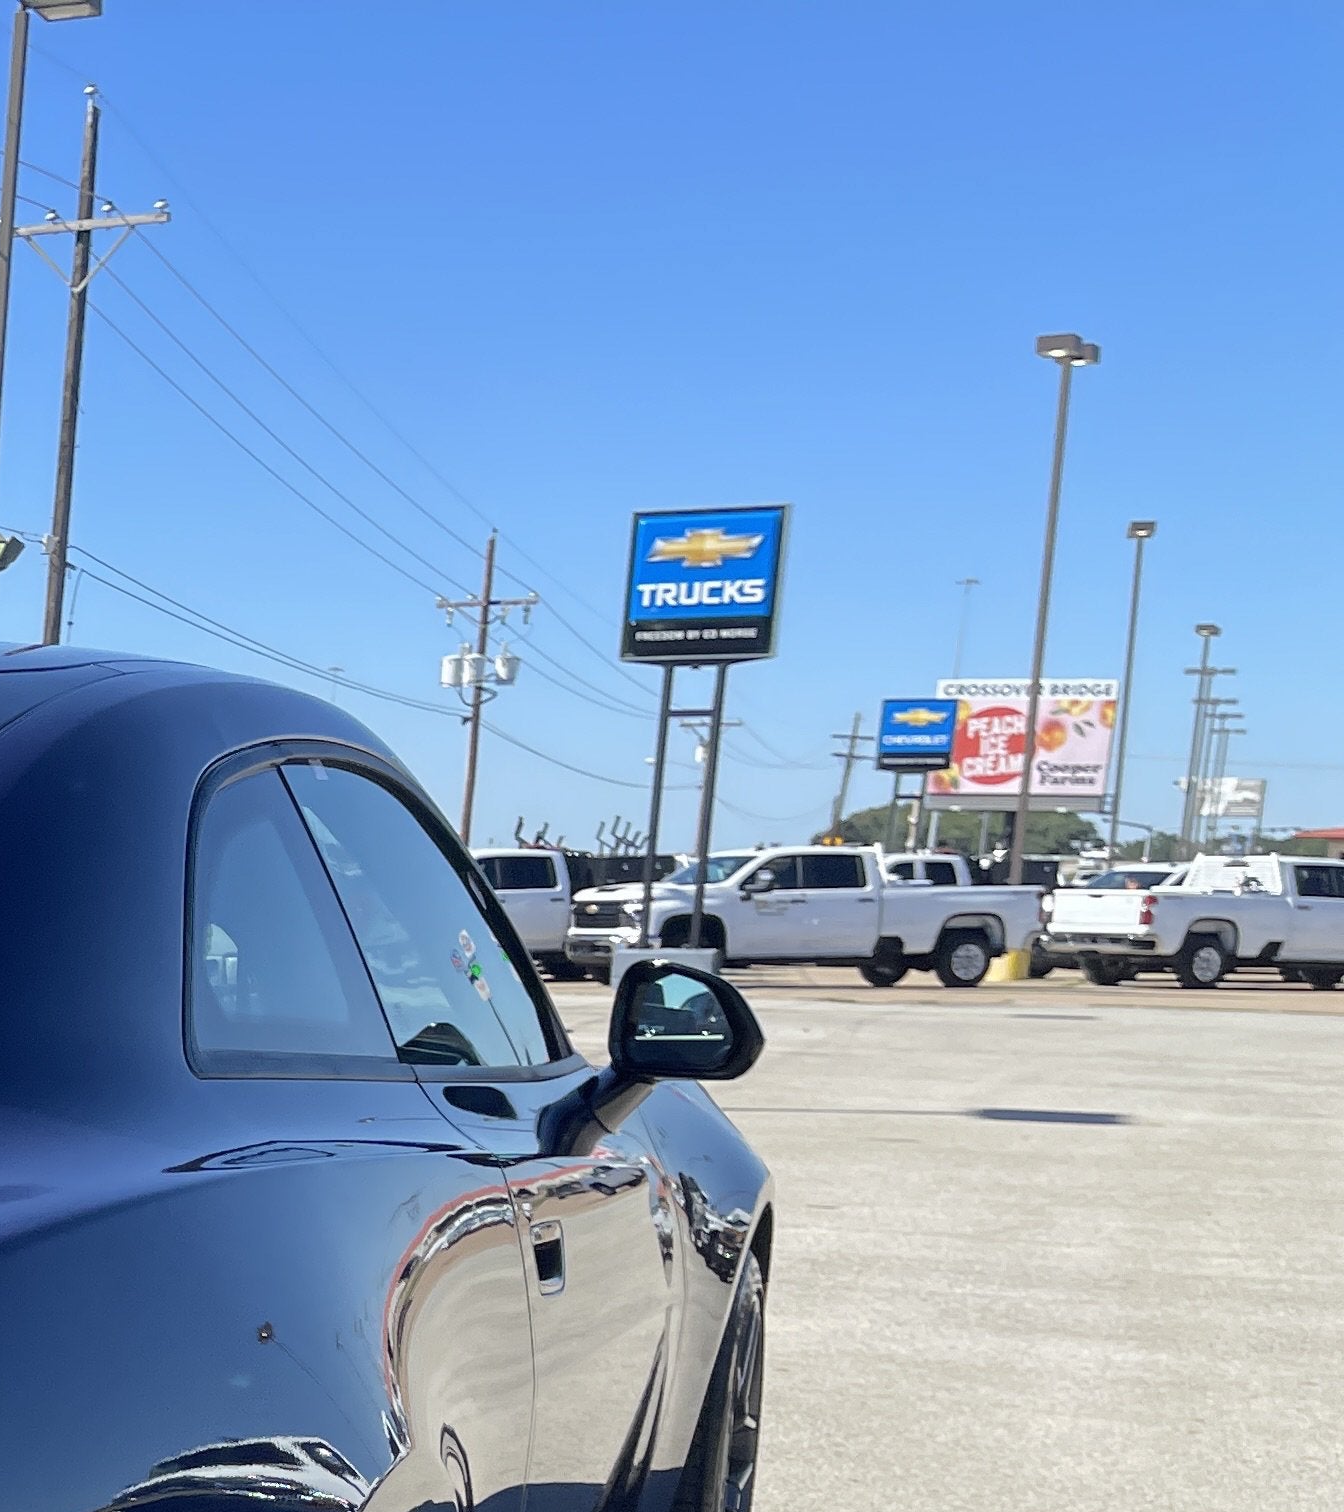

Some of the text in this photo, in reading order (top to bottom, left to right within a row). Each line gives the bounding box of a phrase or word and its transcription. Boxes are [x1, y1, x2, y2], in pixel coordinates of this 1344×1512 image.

[637, 578, 766, 607] TRUCKS
[1050, 683, 1113, 697] BRIDGE
[967, 715, 1027, 739] PEACH
[979, 735, 1009, 756] ICE
[963, 752, 1028, 777] CREAM
[1037, 760, 1102, 776] Cooper
